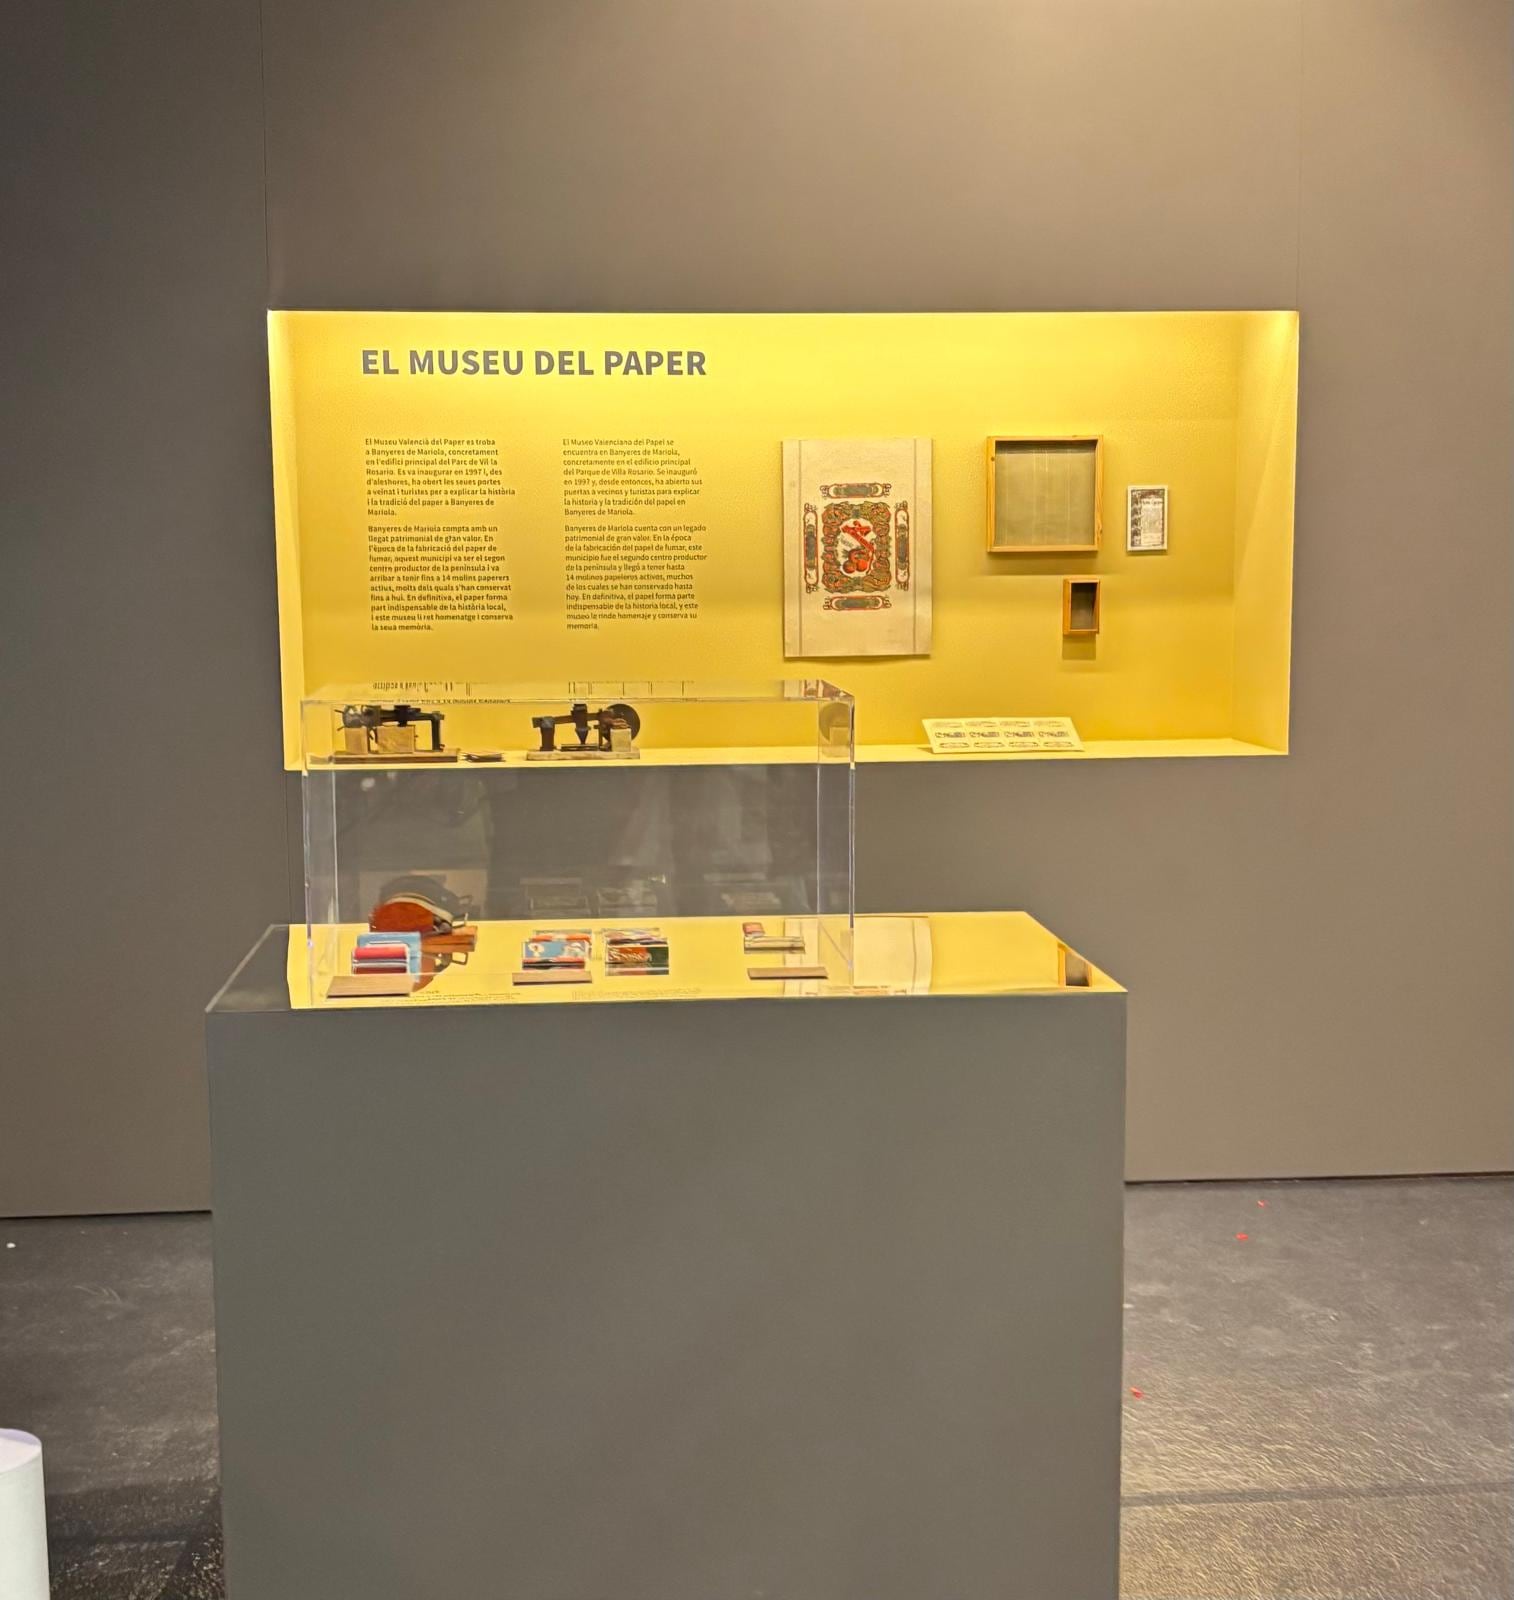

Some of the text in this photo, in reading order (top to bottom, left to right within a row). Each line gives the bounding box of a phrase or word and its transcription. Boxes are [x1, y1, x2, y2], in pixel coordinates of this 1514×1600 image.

[362, 350, 707, 376] EL MUSEU DEL PAPER
[365, 438, 496, 447] El Museu Valencià del Paper troba
[563, 438, 665, 447] El Museo Valenciano del Papel
[372, 448, 499, 457] Banyeres Mariola, concretament
[563, 448, 680, 457] encuentra Banyeres Mariola,
[405, 458, 437, 467] principal
[438, 458, 450, 466] del
[452, 458, 467, 466] Parc
[563, 458, 691, 467] concretamente edificio principal
[398, 468, 406, 476] Es
[417, 468, 452, 478] inaugurar
[465, 468, 482, 476] 1997
[490, 468, 502, 476] des
[563, 467, 575, 475] del
[576, 467, 600, 477] Parque
[612, 467, 626, 475] Villa
[657, 467, 665, 475] Se
[422, 478, 442, 486] obert
[444, 478, 454, 486] les
[478, 478, 501, 487] portes
[574, 477, 590, 485] 1997
[599, 477, 619, 485] desde
[621, 477, 654, 486] entonces,
[666, 477, 690, 485] abierto
[401, 487, 428, 495] turistes
[430, 489, 442, 497] per
[450, 487, 478, 497] explicar
[564, 487, 700, 497] puertas vecinos turistas para explicar
[379, 498, 484, 508] tradició del paper Banyeres
[572, 498, 676, 507] historia tradición del papel
[564, 507, 596, 517] Banyeres
[368, 524, 487, 534] Banyeres Mariola compta amb
[565, 524, 596, 534] Banyeres
[608, 524, 633, 532] Mariola
[634, 523, 658, 531] cuenta
[683, 523, 706, 533] legado
[368, 534, 461, 544] llegat patrimonial gran
[565, 533, 692, 543] patrimonial gran época
[415, 544, 486, 554] fabricació del paper
[583, 543, 702, 553] fabricación del papel este
[395, 554, 419, 563] aquest
[420, 554, 452, 563] municipi
[484, 555, 505, 563] segon
[565, 552, 708, 563] municipio fue segundo centro productor
[394, 564, 430, 574] productor
[647, 562, 665, 570] tener
[666, 562, 685, 570] hasta
[370, 574, 510, 583] arribar fins 14 molins paperers
[566, 573, 574, 581] 14
[576, 573, 603, 581] molinos
[640, 572, 665, 581] activos,
[666, 572, 694, 580] muchos
[370, 583, 394, 592] actius,
[434, 583, 454, 593] quals
[476, 583, 512, 591] conservat
[576, 582, 693, 590] los cuales han conservado hasta
[370, 593, 384, 601] fins
[464, 595, 484, 603] paper
[486, 593, 508, 601] forma
[635, 592, 654, 602] papel
[655, 592, 676, 600] forma
[677, 591, 695, 601] parte
[371, 603, 386, 612] part
[388, 603, 438, 612] indispensable
[486, 603, 506, 612] local,
[566, 601, 699, 612] indispensable historia local, este
[375, 613, 390, 621] este
[423, 613, 434, 621] ret
[435, 613, 476, 622] homenatge
[617, 611, 651, 621] homenaje
